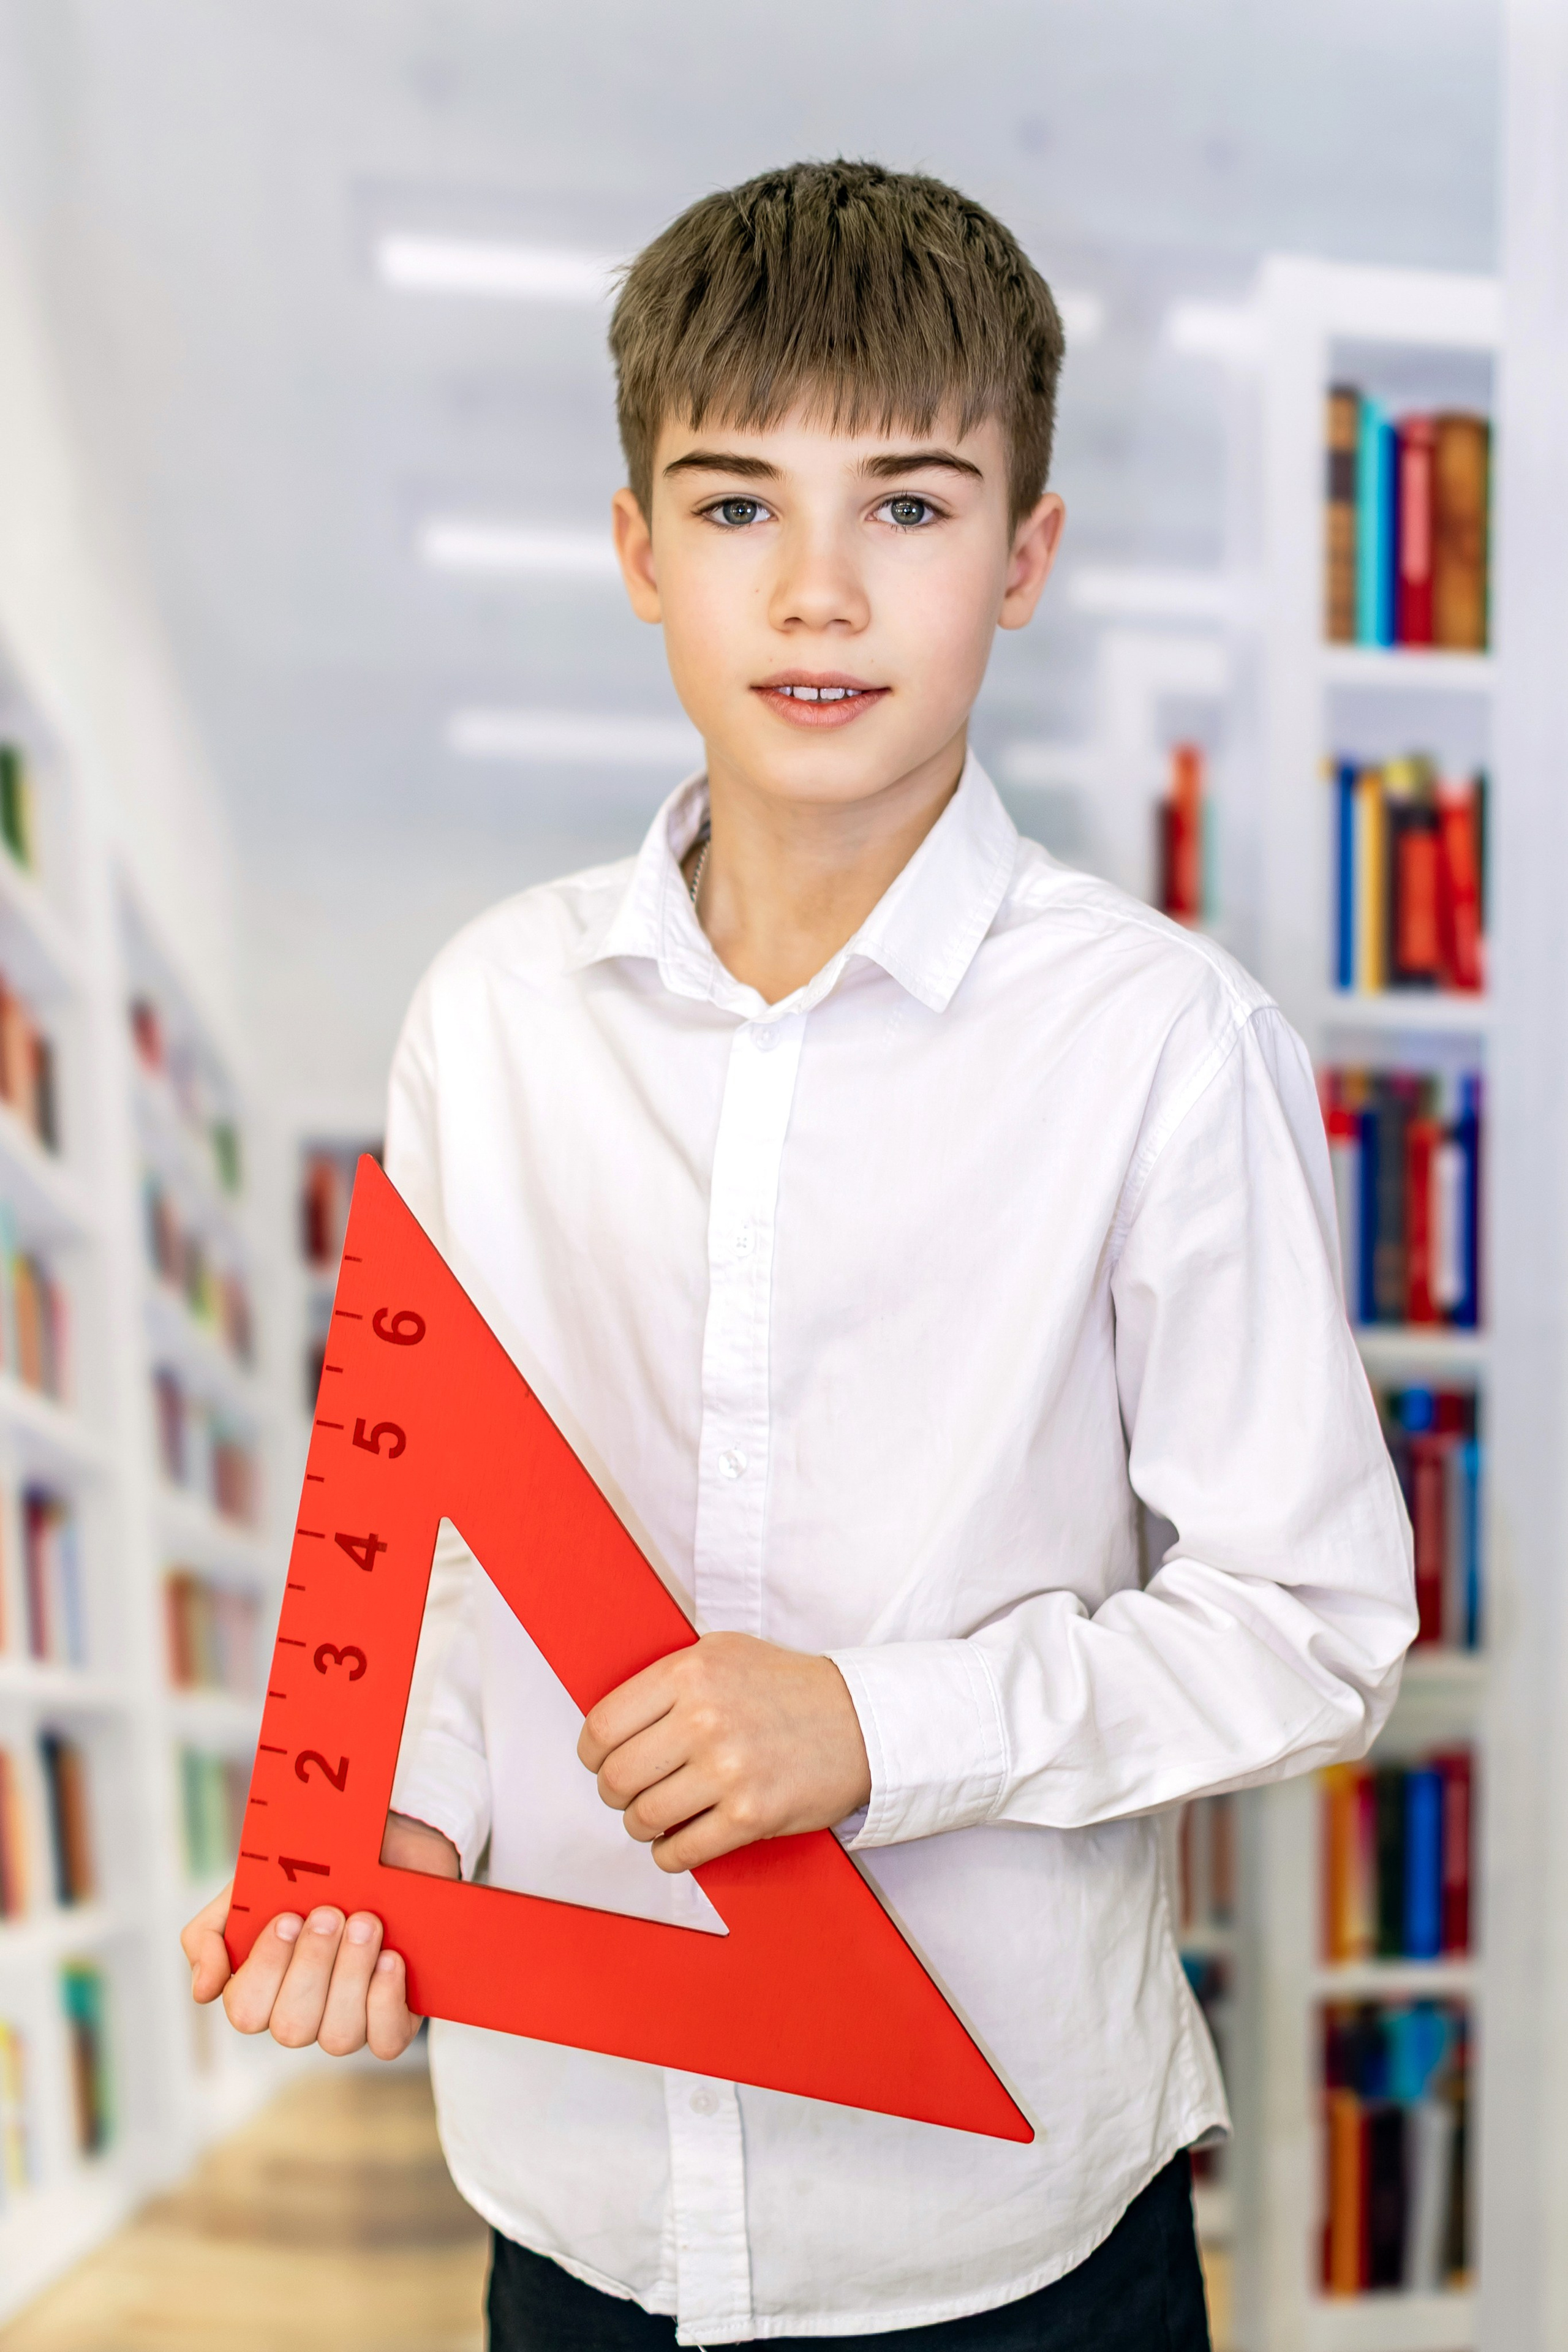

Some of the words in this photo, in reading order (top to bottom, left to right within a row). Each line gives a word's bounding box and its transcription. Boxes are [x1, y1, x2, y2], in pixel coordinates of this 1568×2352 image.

[372, 1308, 426, 1346] 6
[352, 1417, 407, 1460] 5
[334, 1532, 388, 1572] 4
[313, 1643, 368, 1682] 3
[294, 1750, 350, 1793] 2
[277, 1855, 331, 1883] 1
